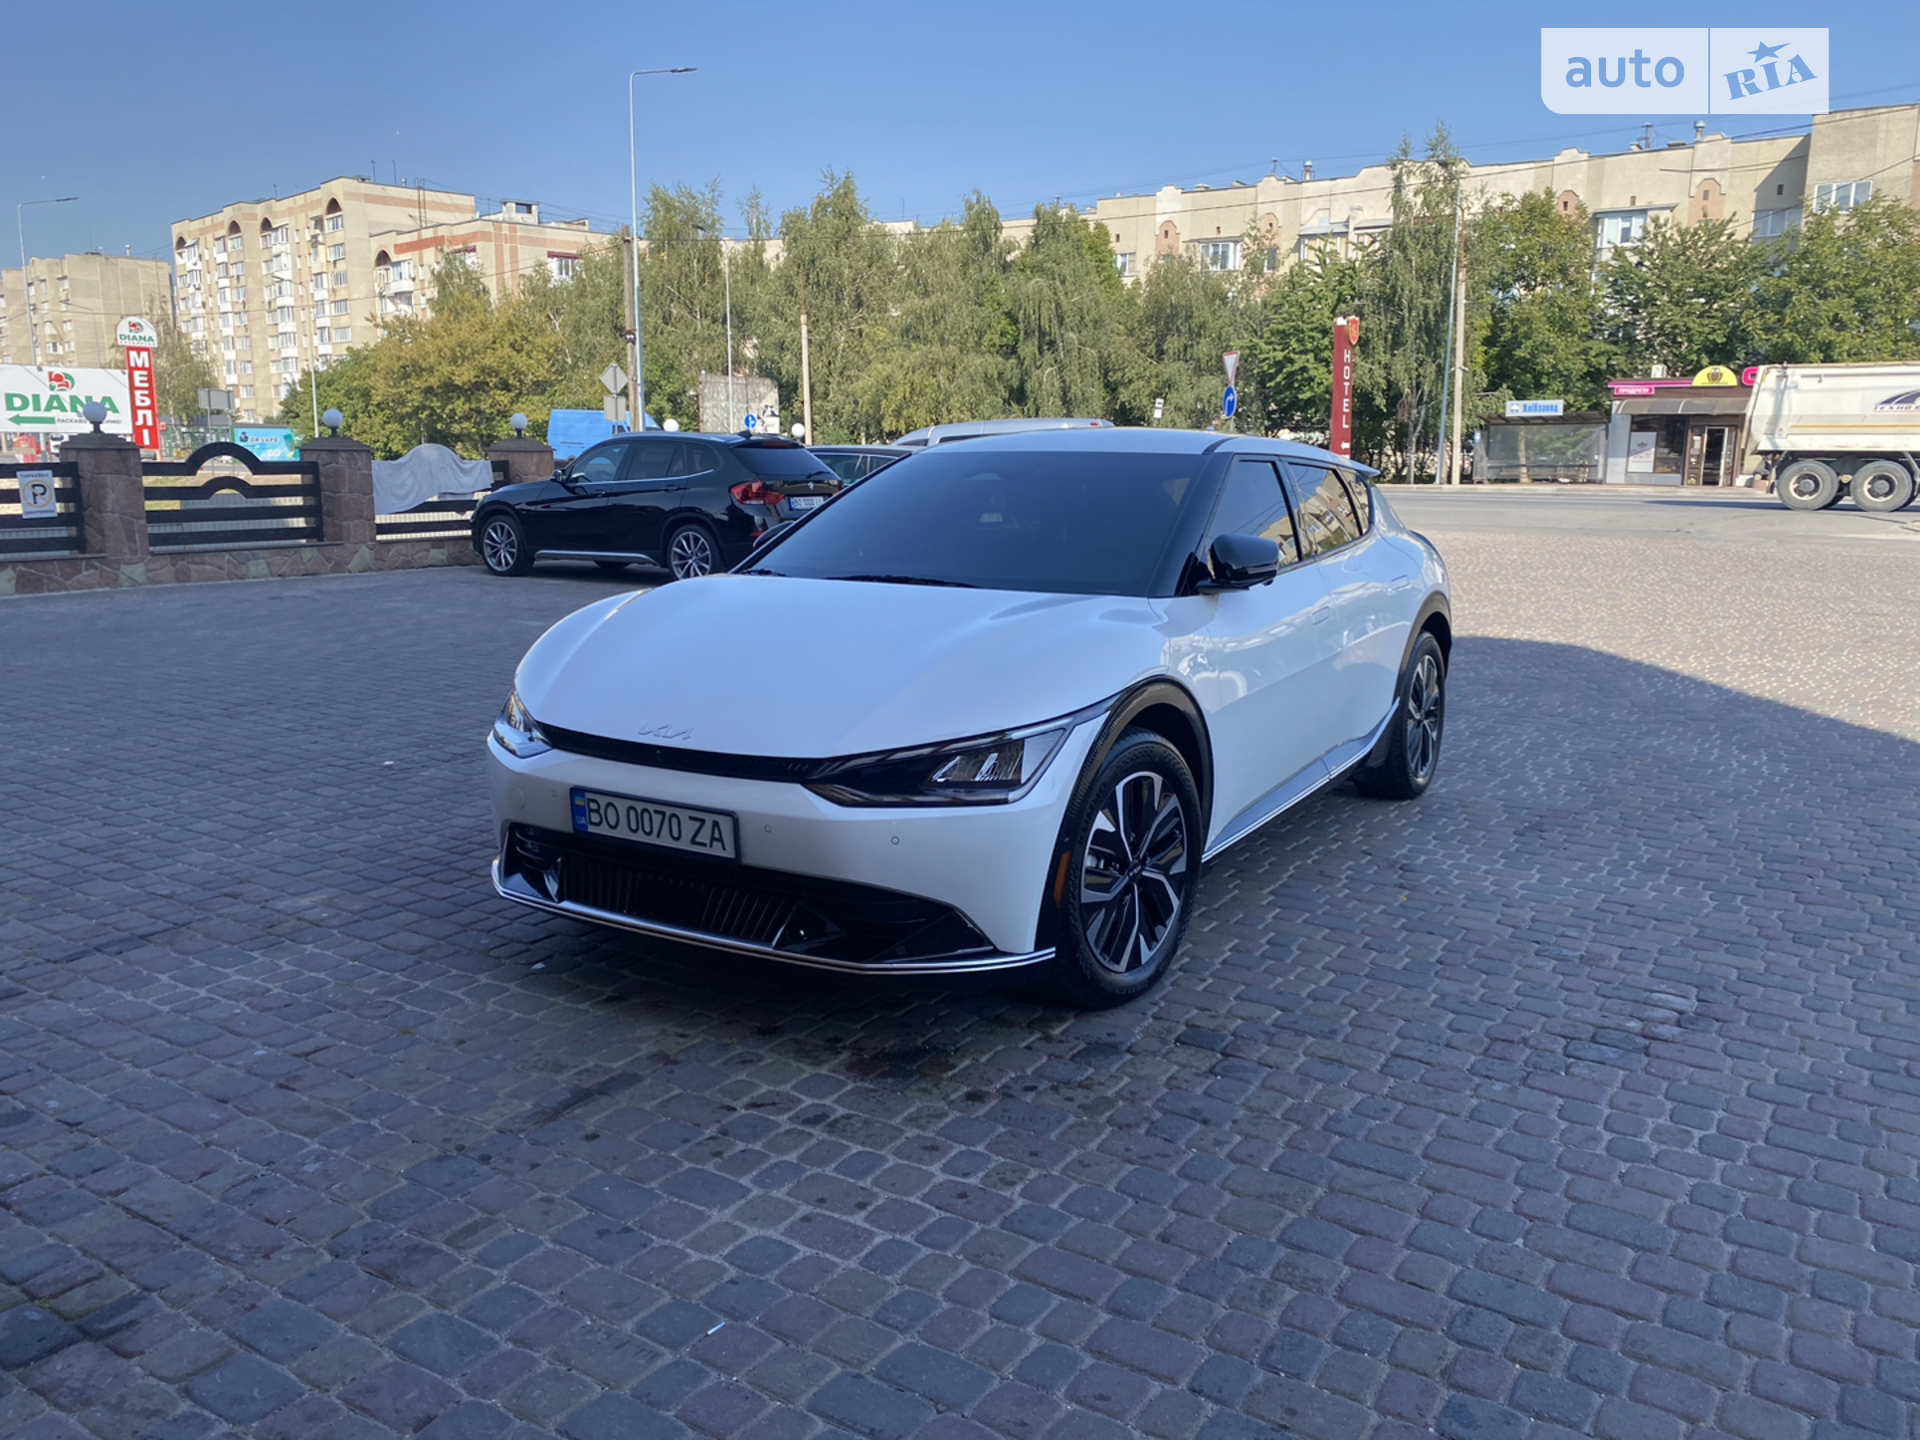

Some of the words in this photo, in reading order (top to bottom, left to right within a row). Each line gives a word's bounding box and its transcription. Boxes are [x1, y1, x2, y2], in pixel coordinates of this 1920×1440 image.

[119, 334, 155, 342] DIANA
[4, 393, 121, 414] DIANA
[128, 350, 153, 446] МЕБЛІ
[1342, 349, 1351, 429] HOTEL
[587, 798, 620, 830] BO
[626, 805, 682, 842] 0070
[688, 815, 727, 851] ZA
